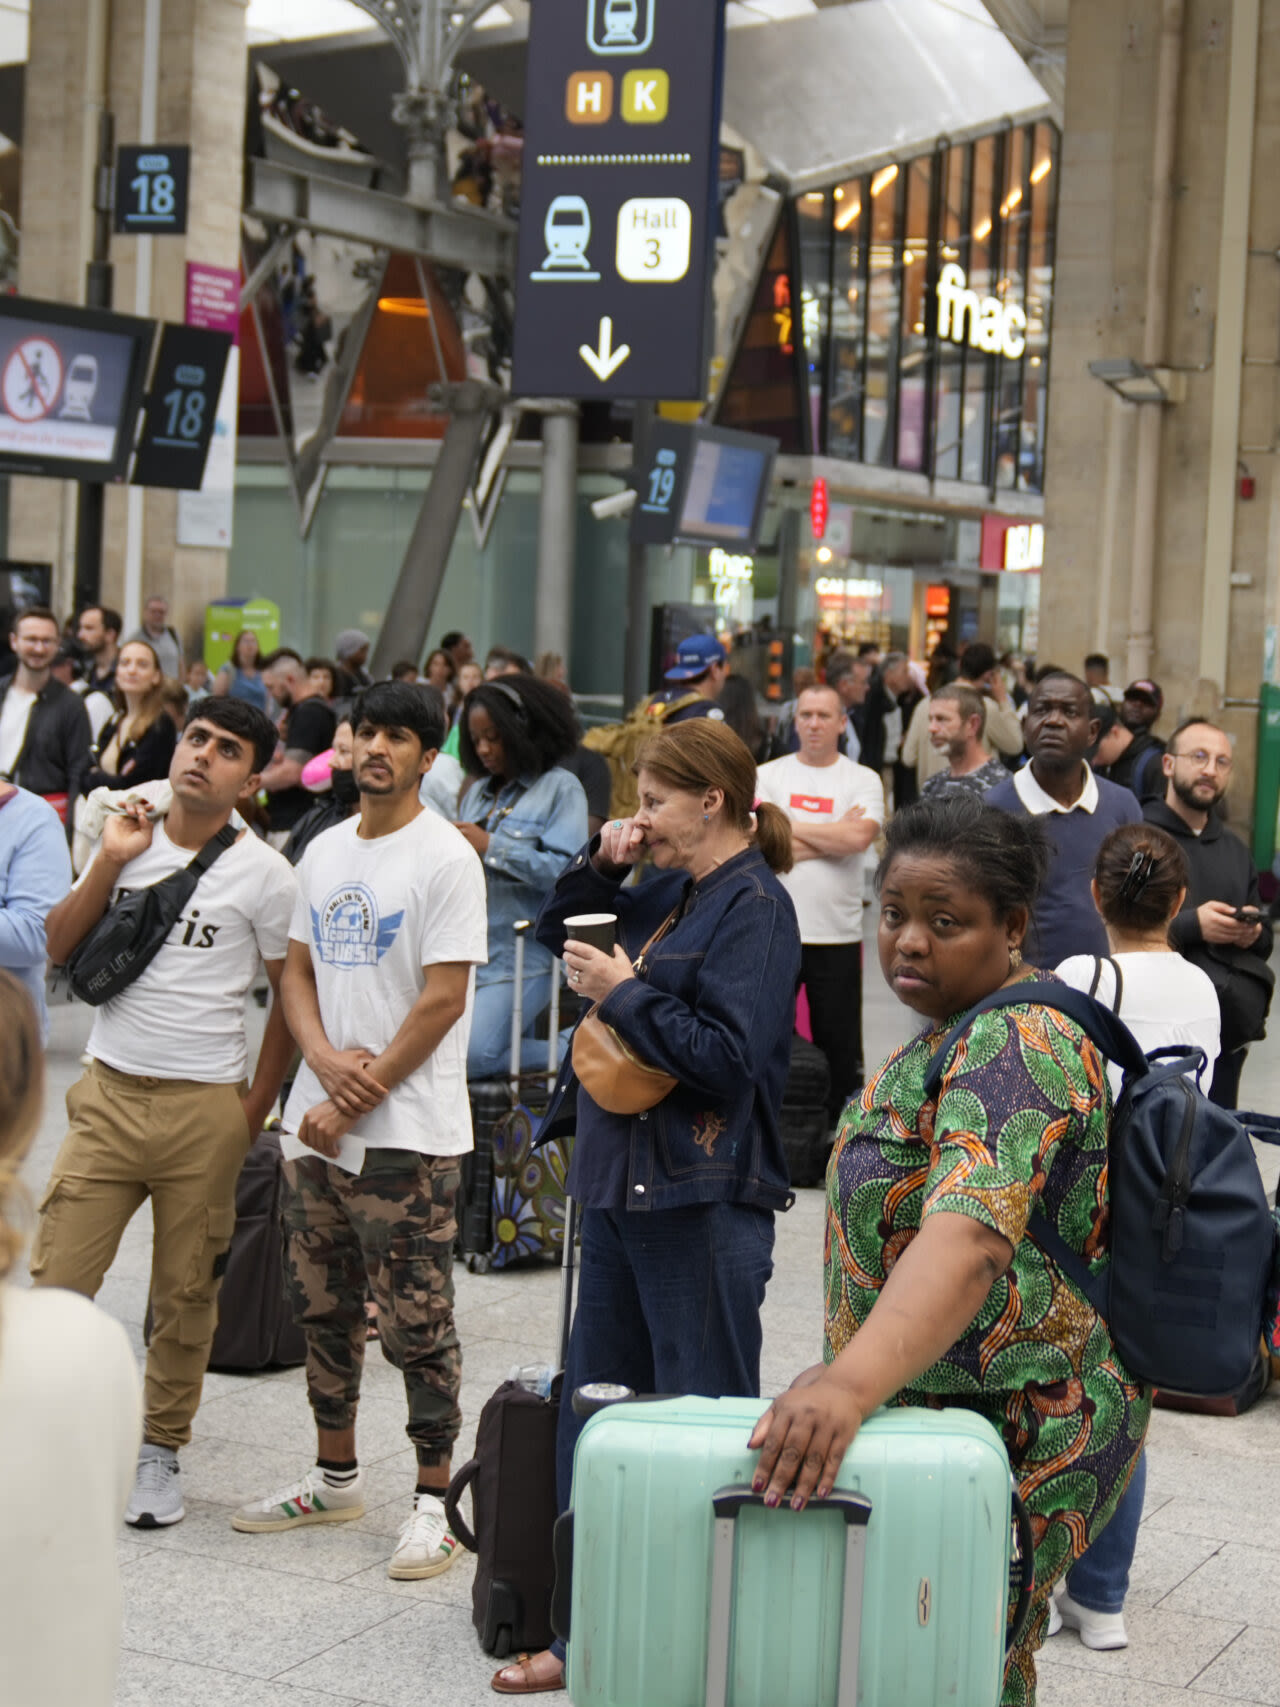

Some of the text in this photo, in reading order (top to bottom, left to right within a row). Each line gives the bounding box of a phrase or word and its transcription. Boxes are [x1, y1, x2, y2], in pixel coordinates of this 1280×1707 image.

[575, 79, 658, 114] H K
[130, 173, 176, 214] 18
[631, 207, 678, 230] Hall
[643, 237, 661, 269] 3
[936, 263, 1026, 360] fnac
[163, 388, 206, 439] 18
[648, 467, 675, 505] 19
[87, 949, 136, 993] FREE LIFE
